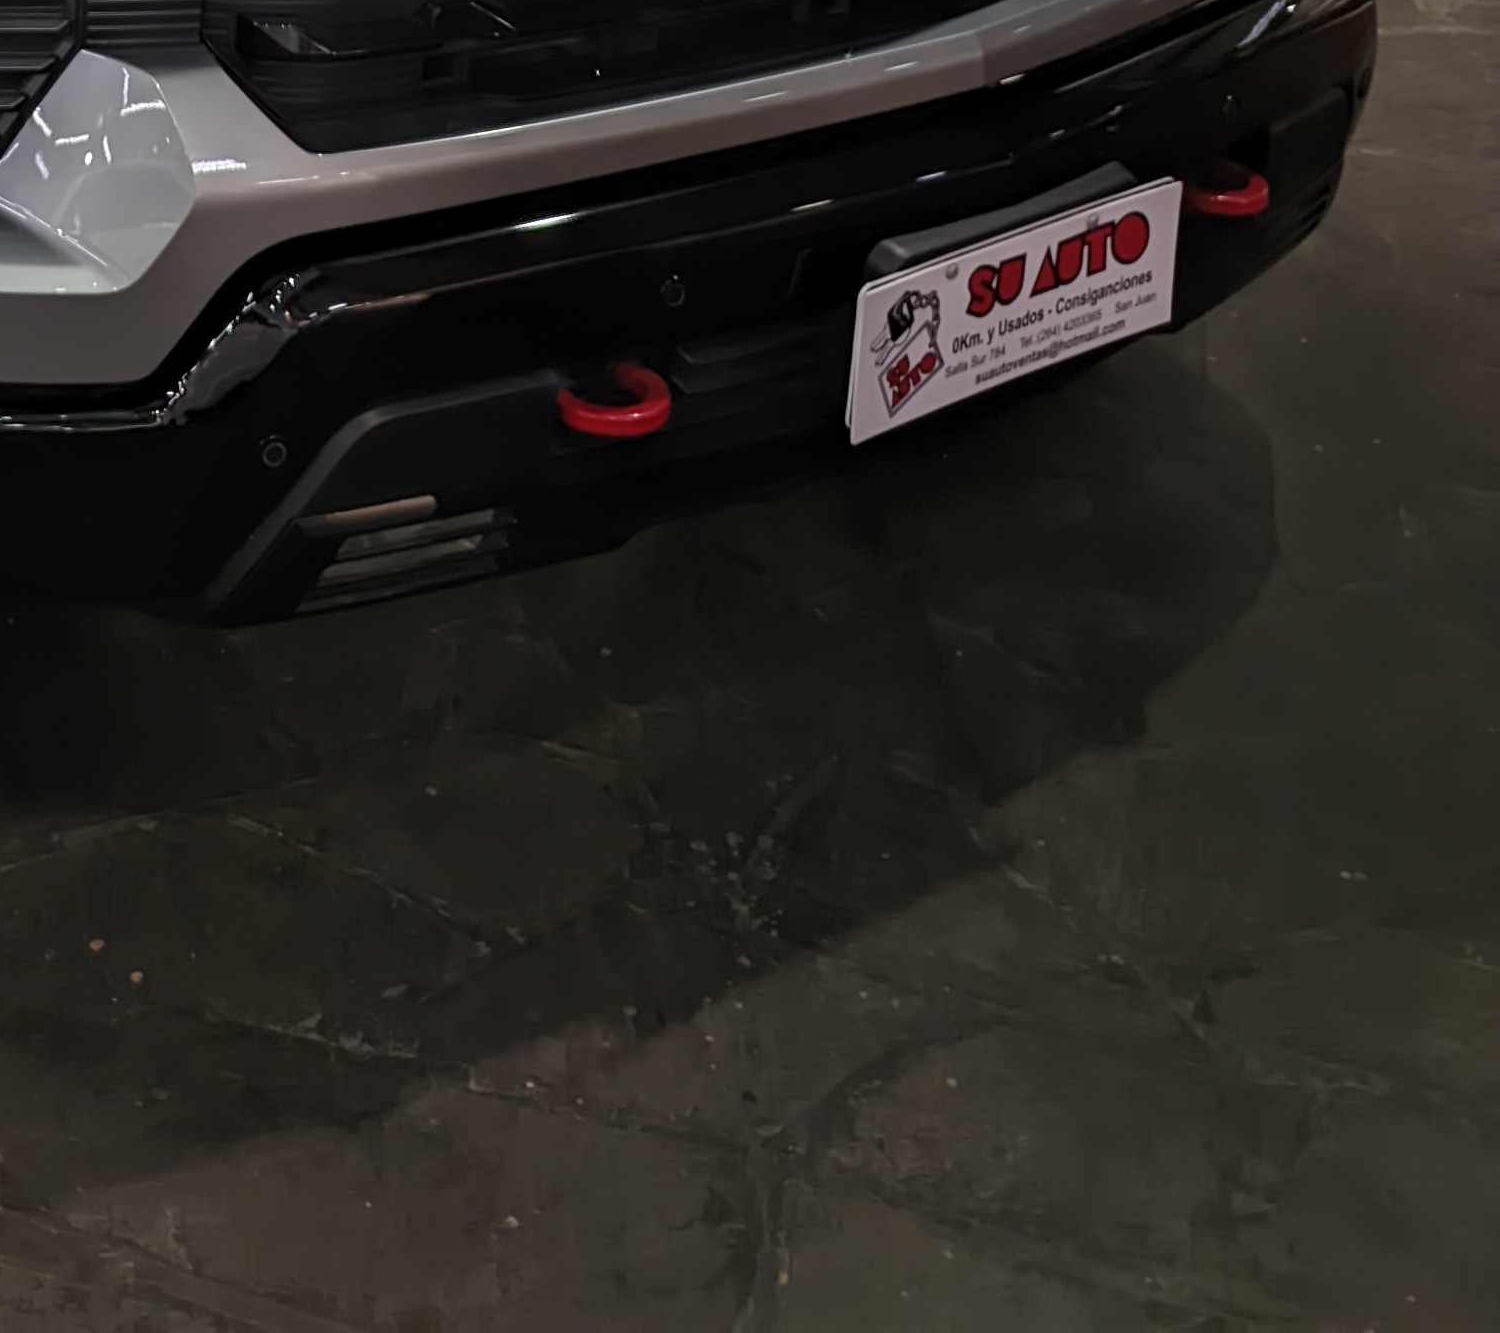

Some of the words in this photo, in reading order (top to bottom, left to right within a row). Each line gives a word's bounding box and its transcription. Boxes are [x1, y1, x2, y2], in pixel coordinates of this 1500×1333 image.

[966, 252, 1027, 317] SU
[1029, 211, 1150, 298] AUTO
[987, 327, 995, 344] y
[999, 308, 1044, 335] Usados
[1115, 300, 1132, 313] San
[892, 351, 937, 409] AUTO
